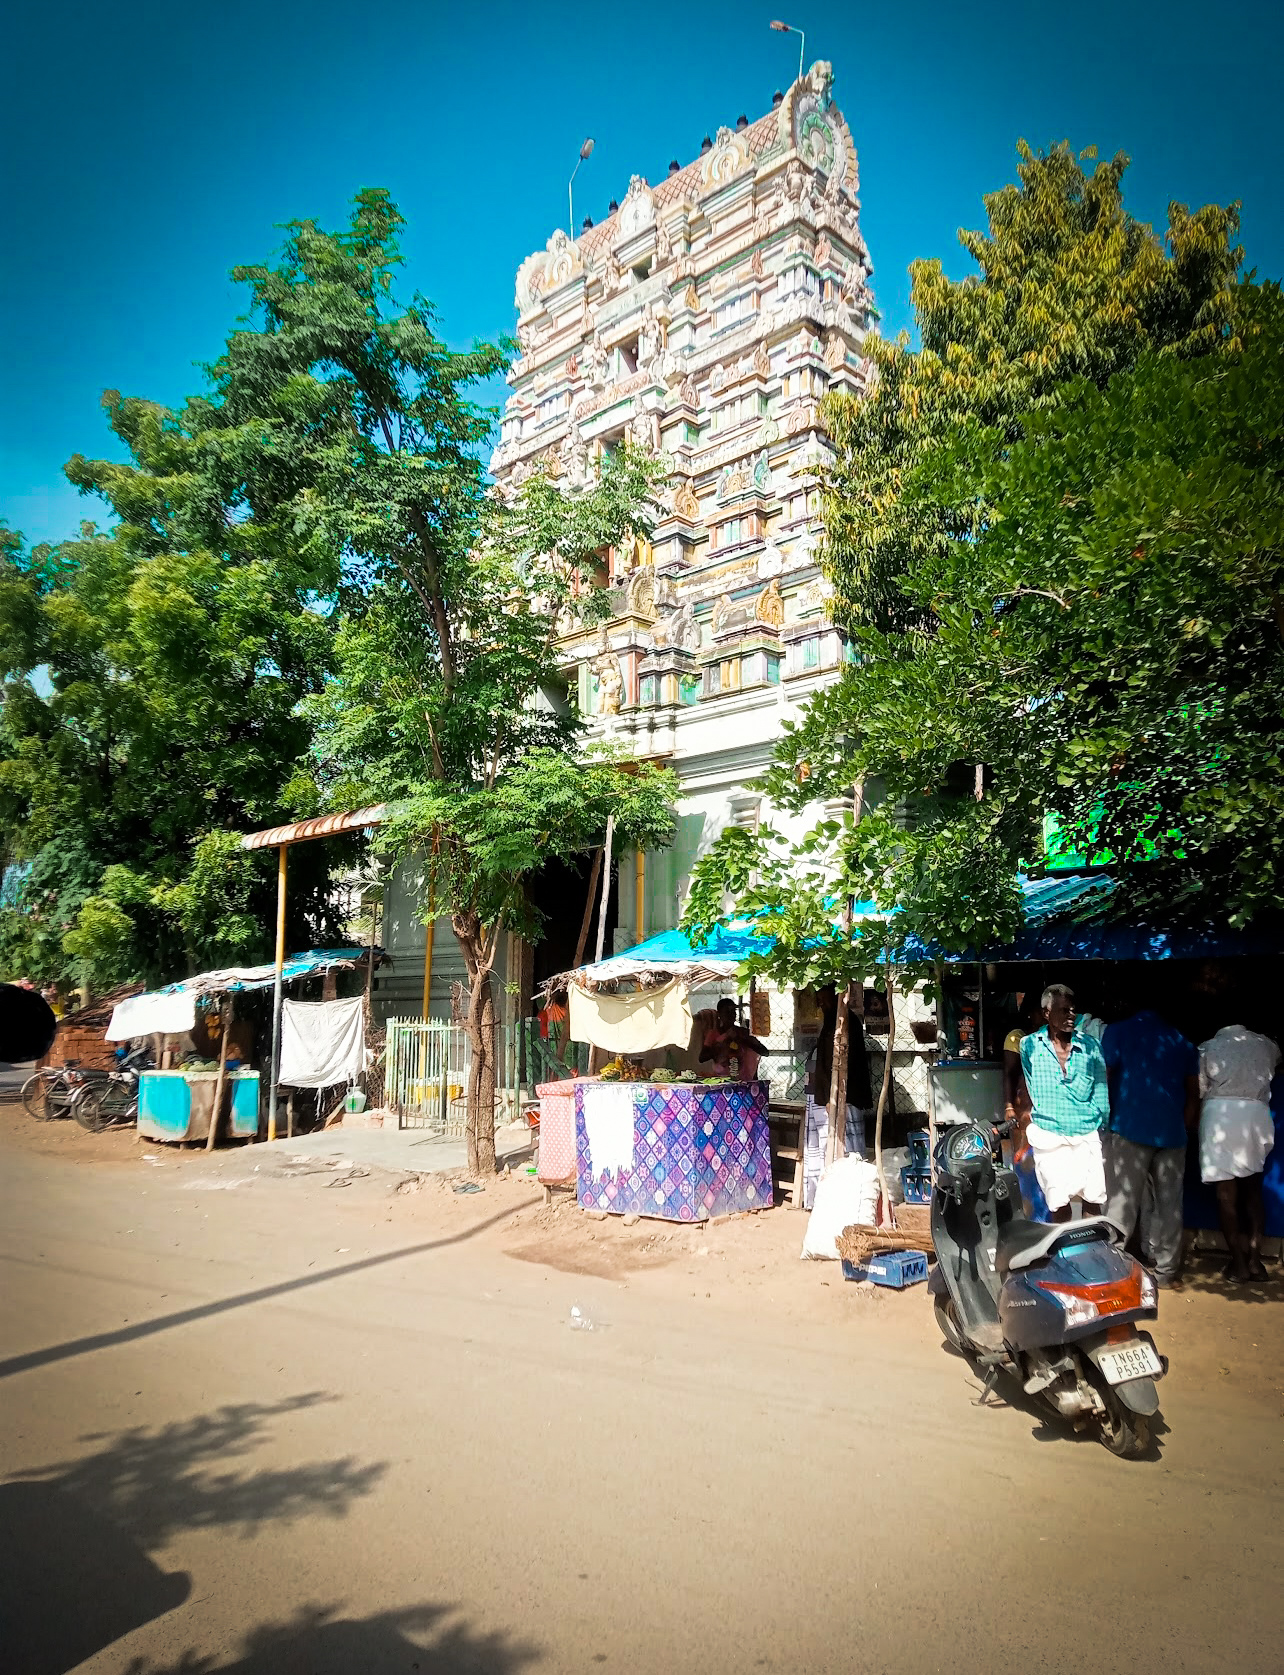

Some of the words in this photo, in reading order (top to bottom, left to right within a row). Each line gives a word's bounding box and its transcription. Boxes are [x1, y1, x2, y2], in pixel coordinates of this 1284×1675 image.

[1069, 1230, 1096, 1239] HONDA
[1111, 1348, 1148, 1366] TN66A
[1116, 1360, 1153, 1379] P5591
